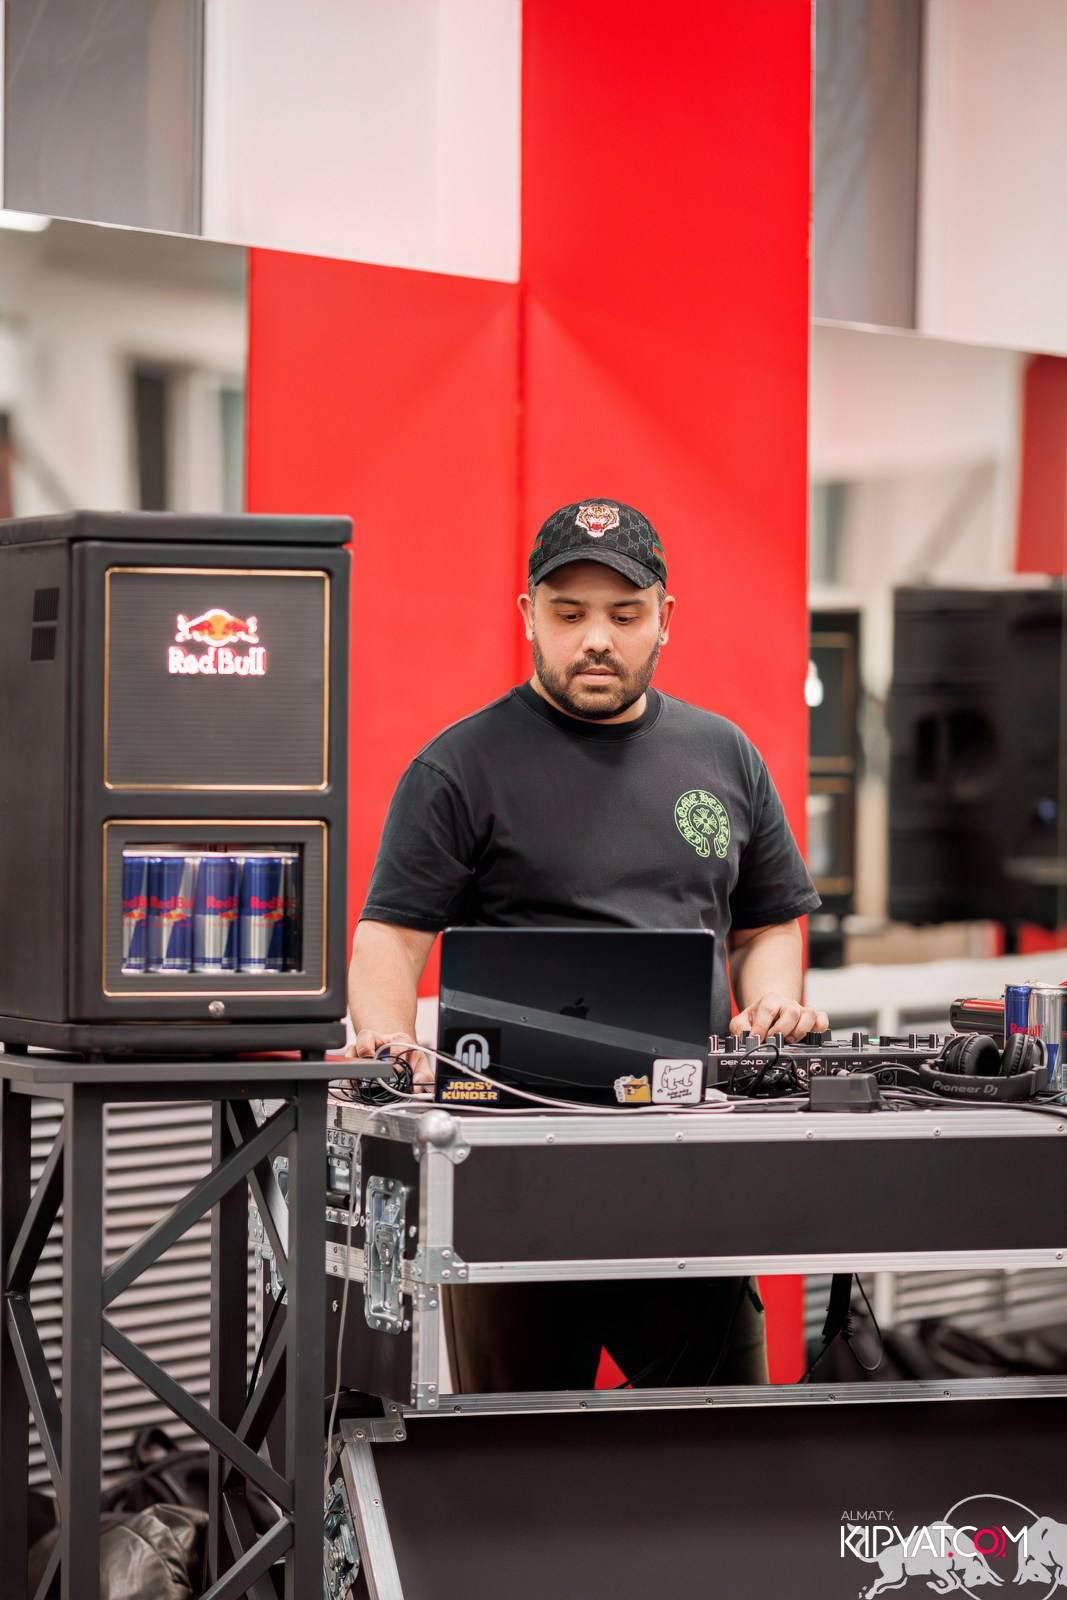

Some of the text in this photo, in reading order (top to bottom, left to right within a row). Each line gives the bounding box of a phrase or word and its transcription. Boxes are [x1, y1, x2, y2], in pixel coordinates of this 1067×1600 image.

[168, 646, 267, 676] Red Bull
[932, 1079, 981, 1093] Pioneer
